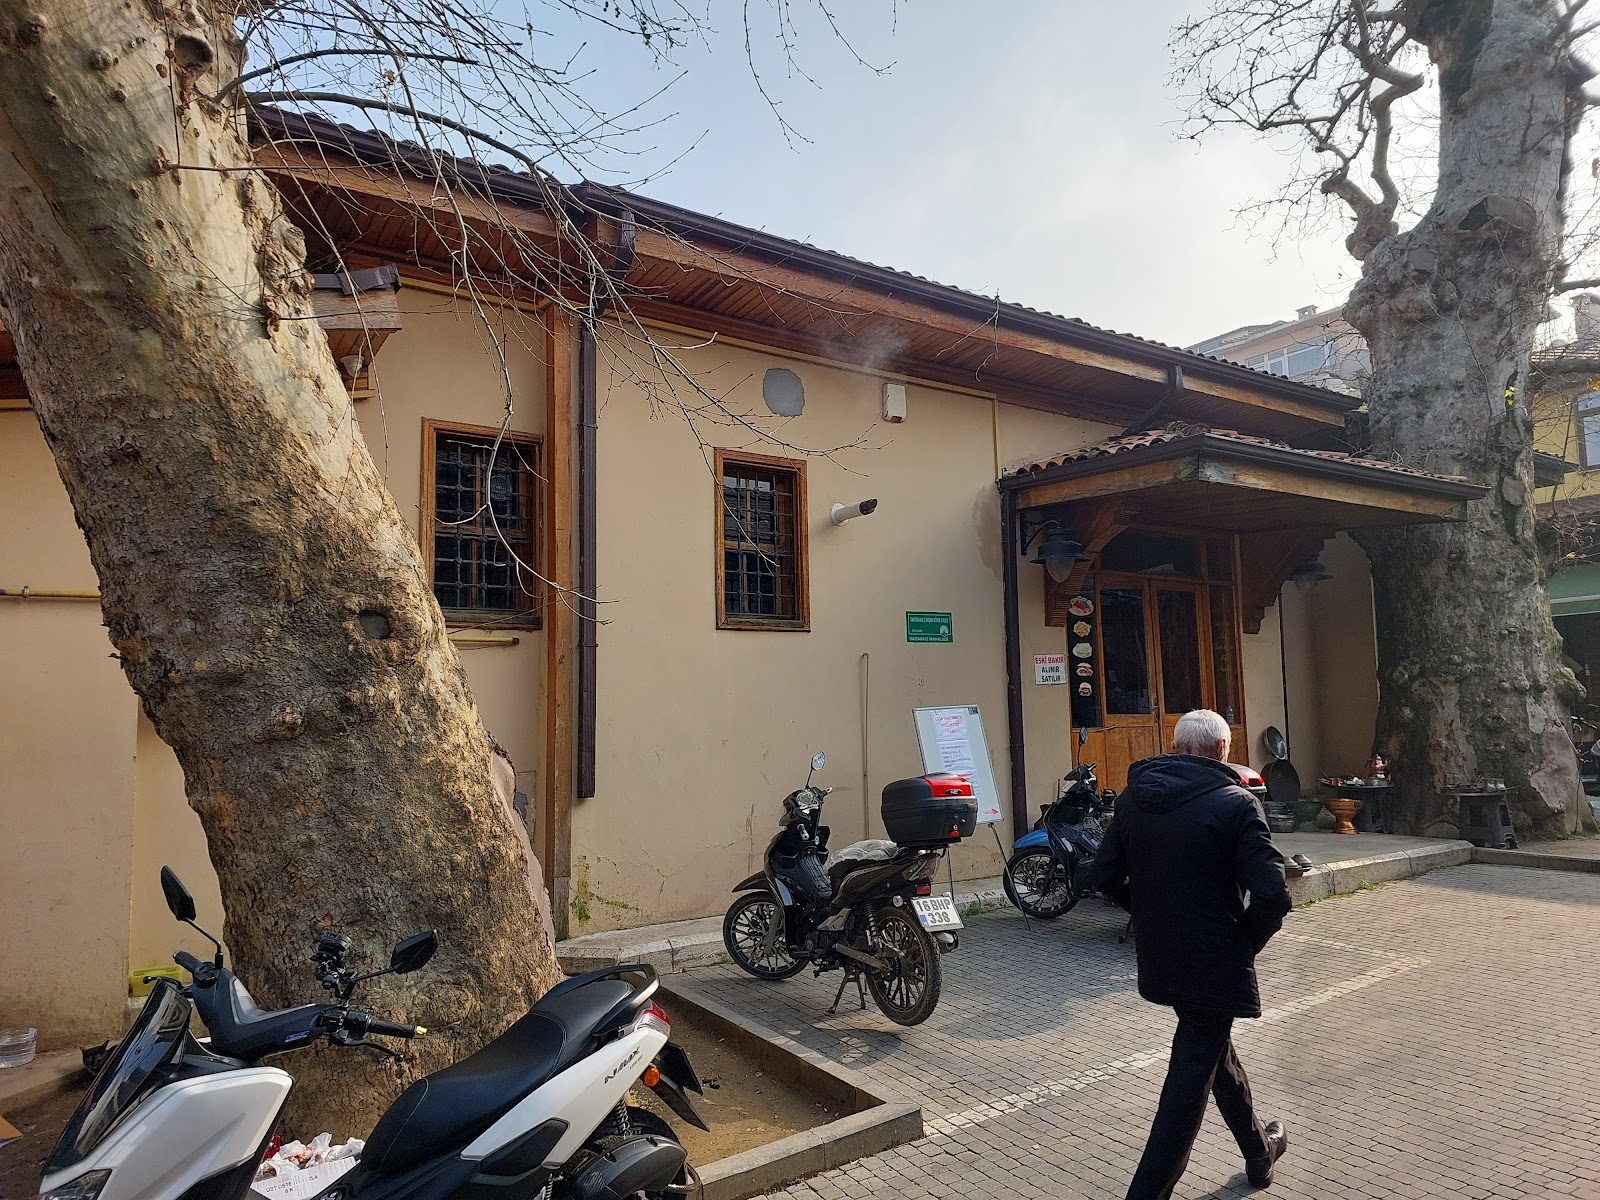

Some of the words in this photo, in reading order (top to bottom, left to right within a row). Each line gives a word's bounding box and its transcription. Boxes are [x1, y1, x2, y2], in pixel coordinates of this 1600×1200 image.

[1035, 655, 1047, 665] ESKİ
[1047, 656, 1064, 664] BAKIR
[1041, 665, 1060, 674] ALINIR
[1041, 675, 1061, 683] SATILIR
[915, 900, 931, 912] 16
[930, 898, 951, 911] BHP
[928, 911, 951, 924] 338
